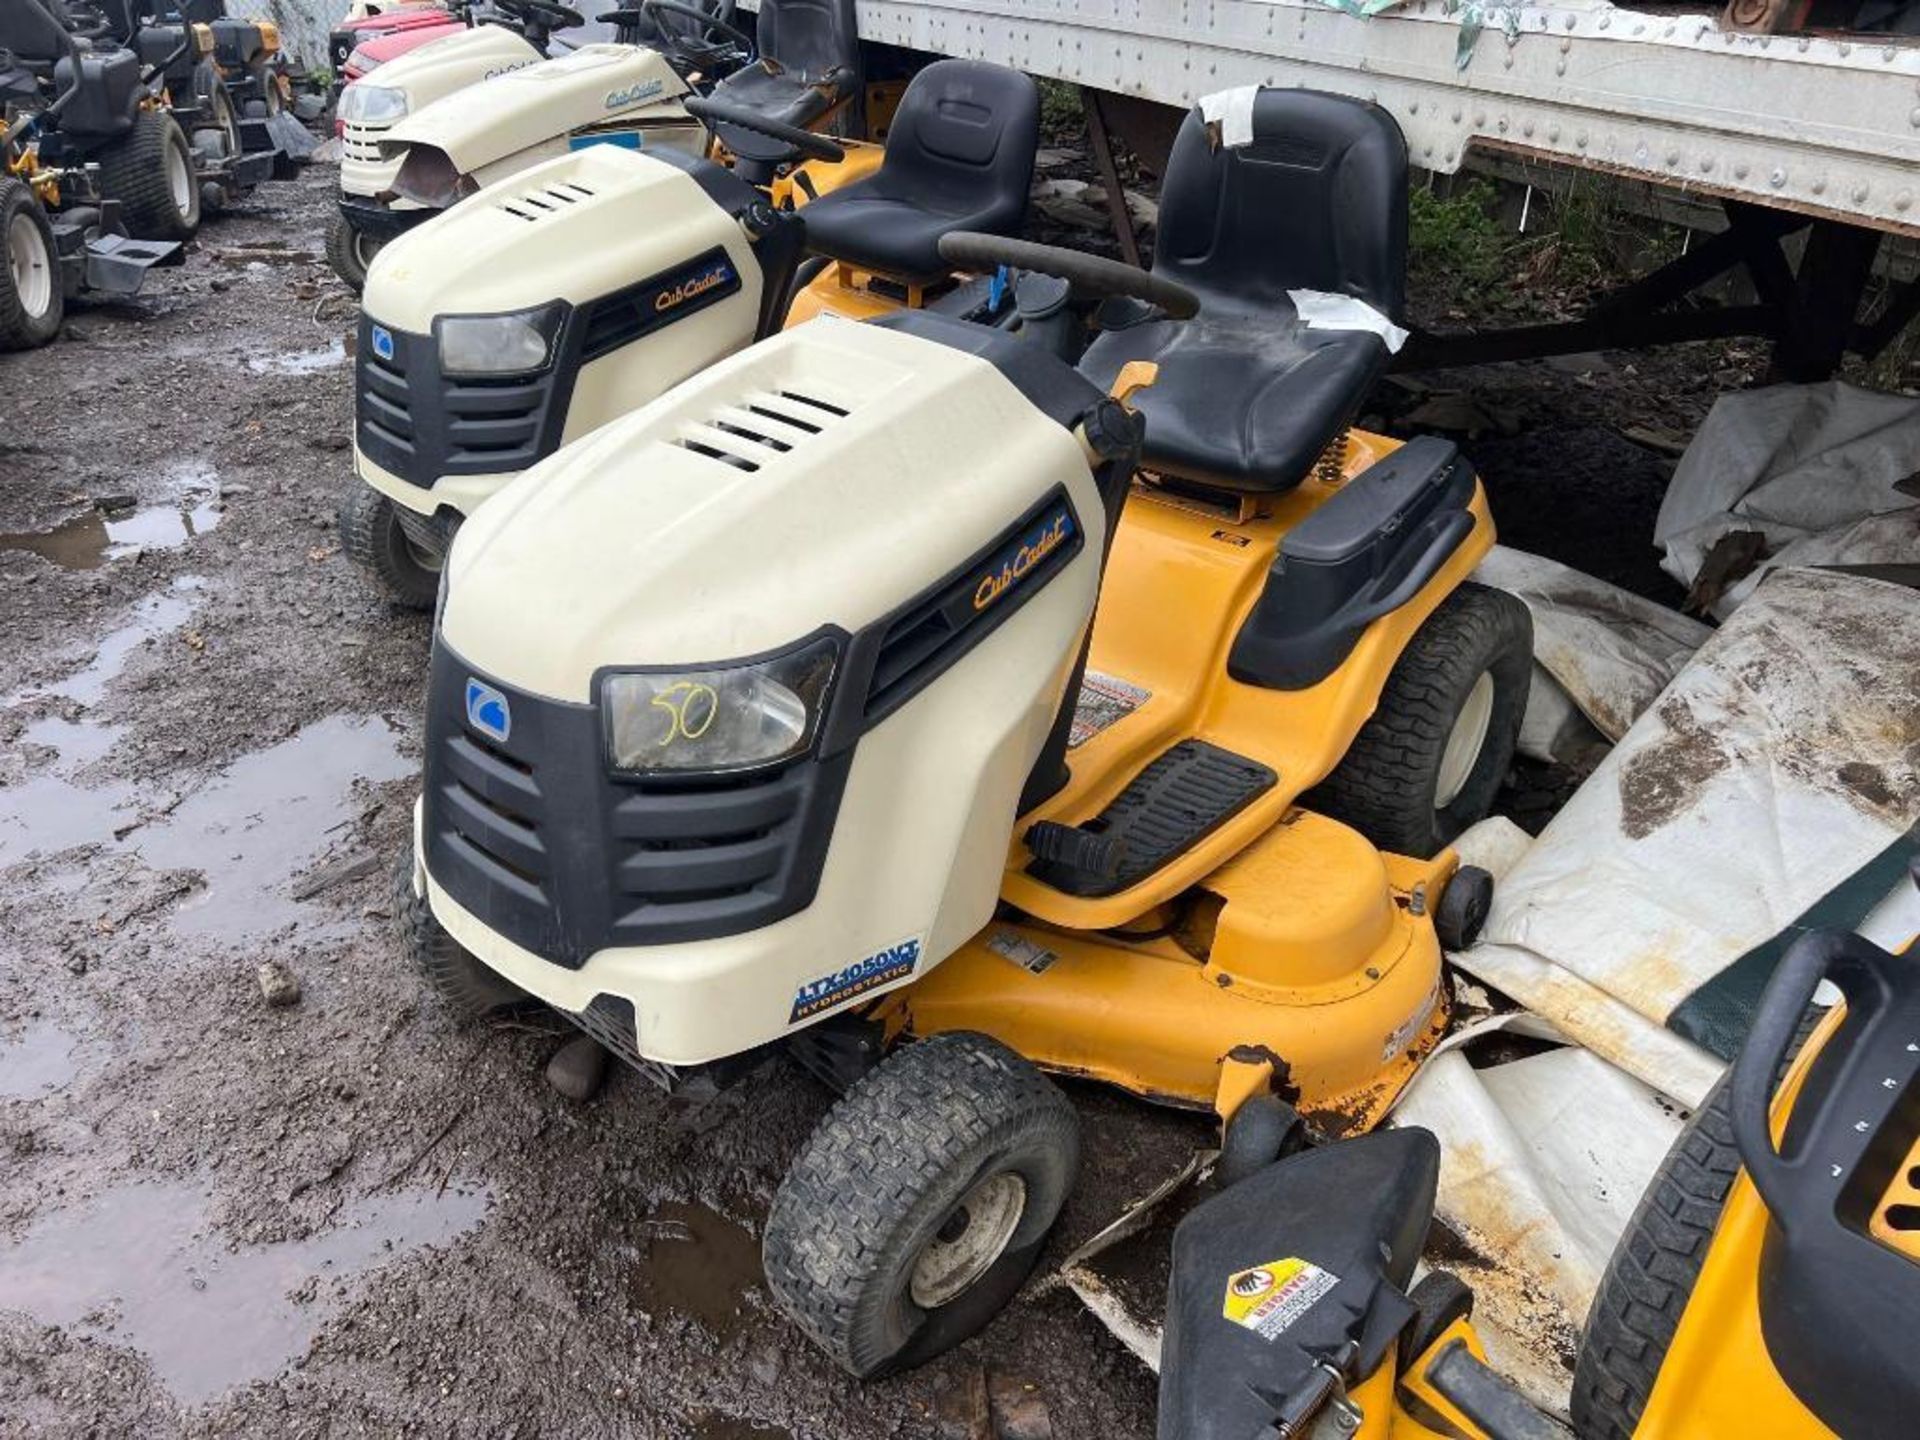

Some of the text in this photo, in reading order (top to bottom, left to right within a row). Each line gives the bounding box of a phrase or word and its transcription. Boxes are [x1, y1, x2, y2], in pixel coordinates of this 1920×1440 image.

[655, 266, 726, 311] Cub Cadet
[974, 513, 1066, 610] Cub Cadet
[651, 682, 718, 746] 50
[797, 962, 909, 1017] HYDROSTATIC
[1254, 1273, 1310, 1318] DANGER
